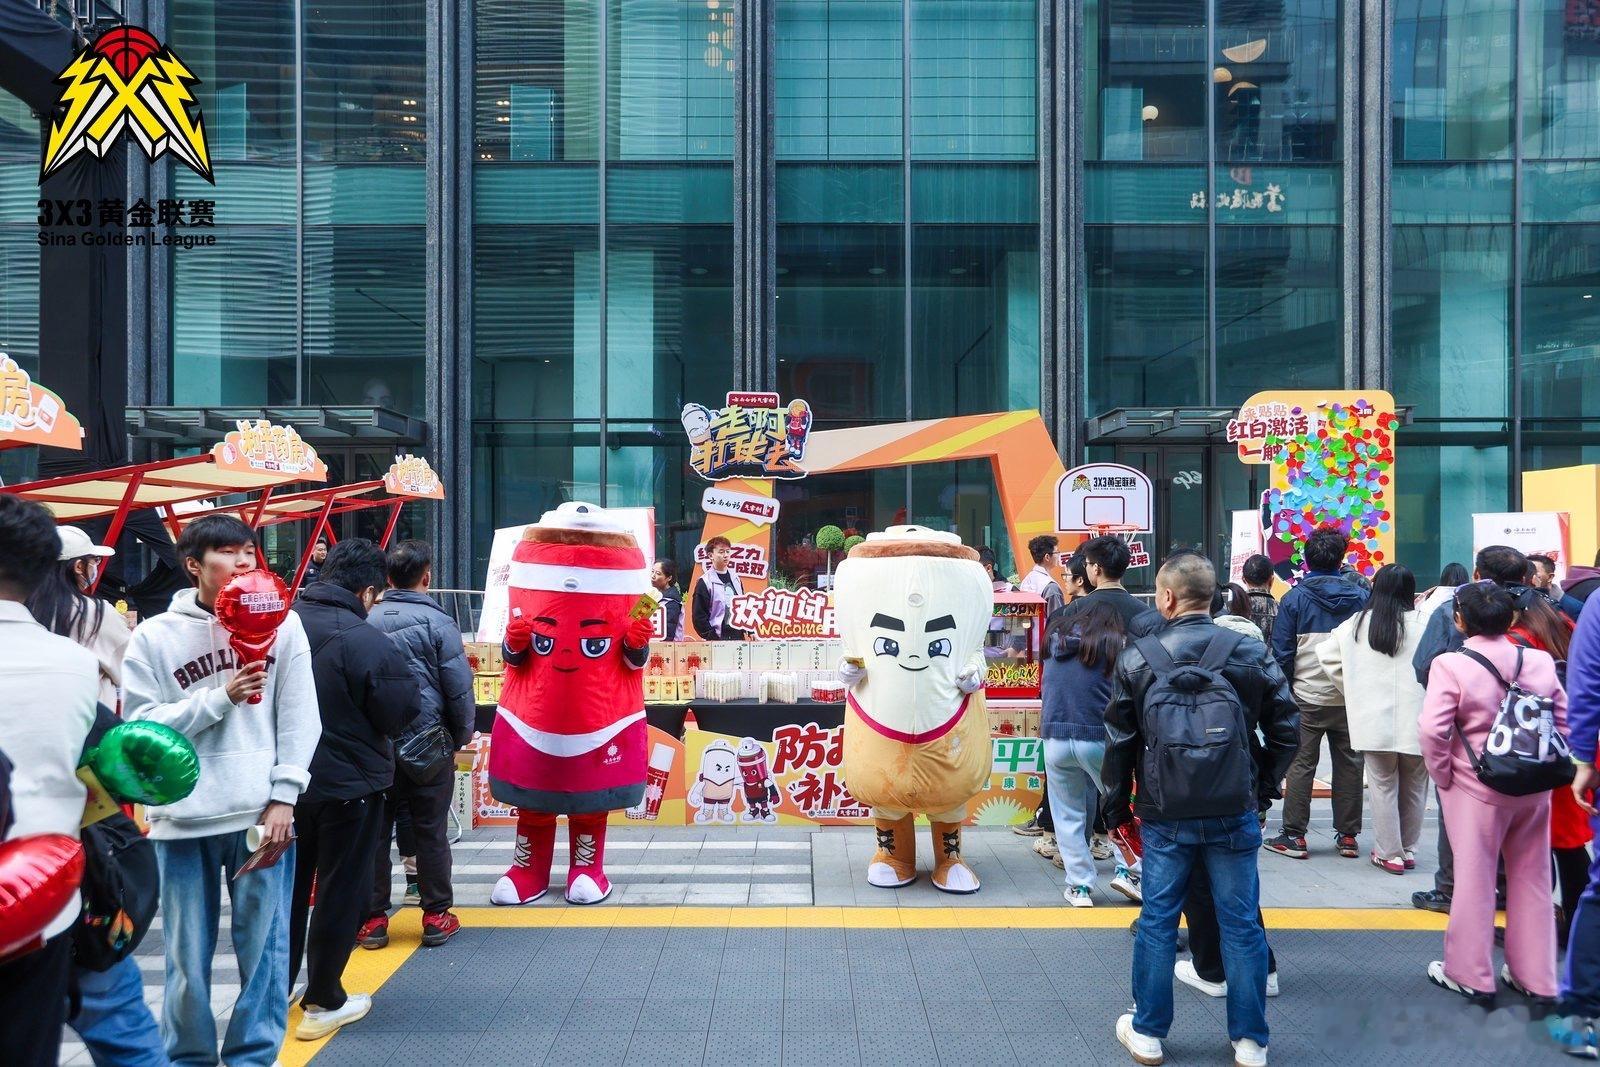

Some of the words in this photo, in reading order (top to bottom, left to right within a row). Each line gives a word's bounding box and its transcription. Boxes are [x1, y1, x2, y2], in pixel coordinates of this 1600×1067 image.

[1228, 415, 1309, 439] 红白激活
[987, 667, 1037, 681] POPCORN
